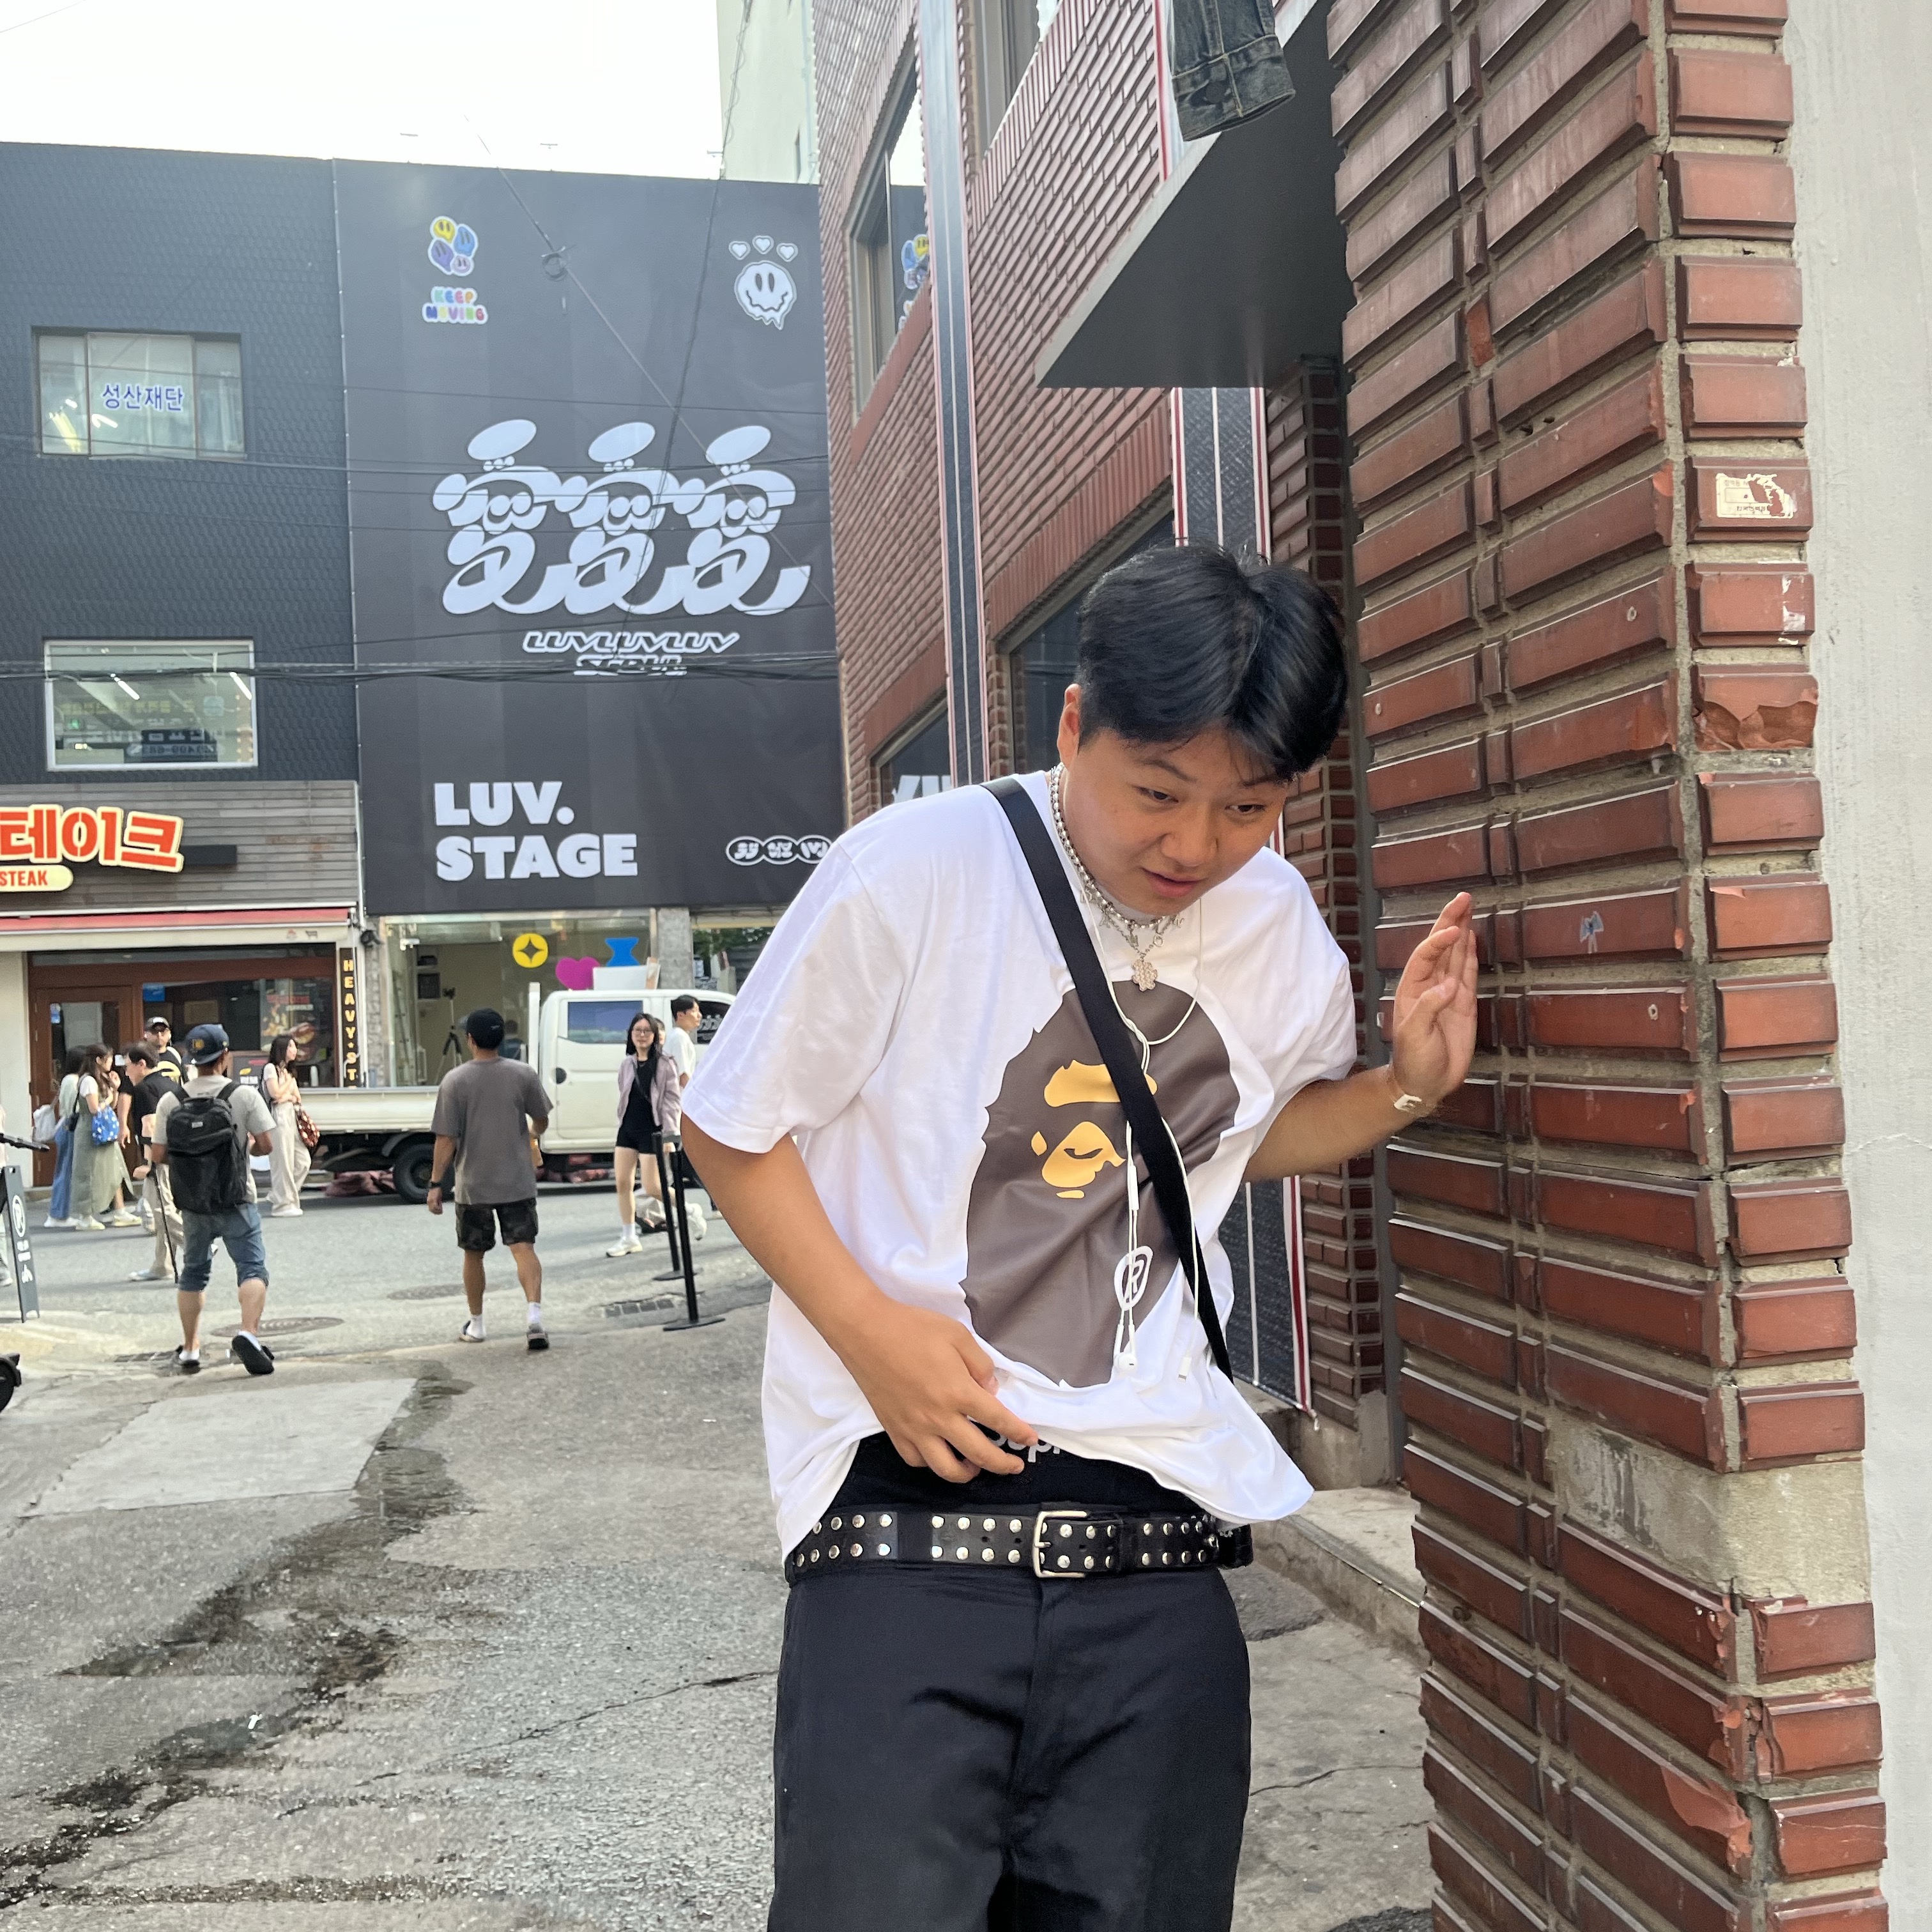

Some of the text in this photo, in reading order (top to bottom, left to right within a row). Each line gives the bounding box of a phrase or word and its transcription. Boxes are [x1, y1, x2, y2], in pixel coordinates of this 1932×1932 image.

[433, 288, 476, 304] KEEP
[424, 304, 487, 322] MOVING
[101, 383, 184, 411] 성산재단
[523, 631, 740, 653] LUVLUVLUV
[434, 781, 574, 826] LUV.
[436, 832, 638, 881] STAGE
[0, 870, 49, 887] STEAK
[343, 959, 357, 1088] HEAVY ST
